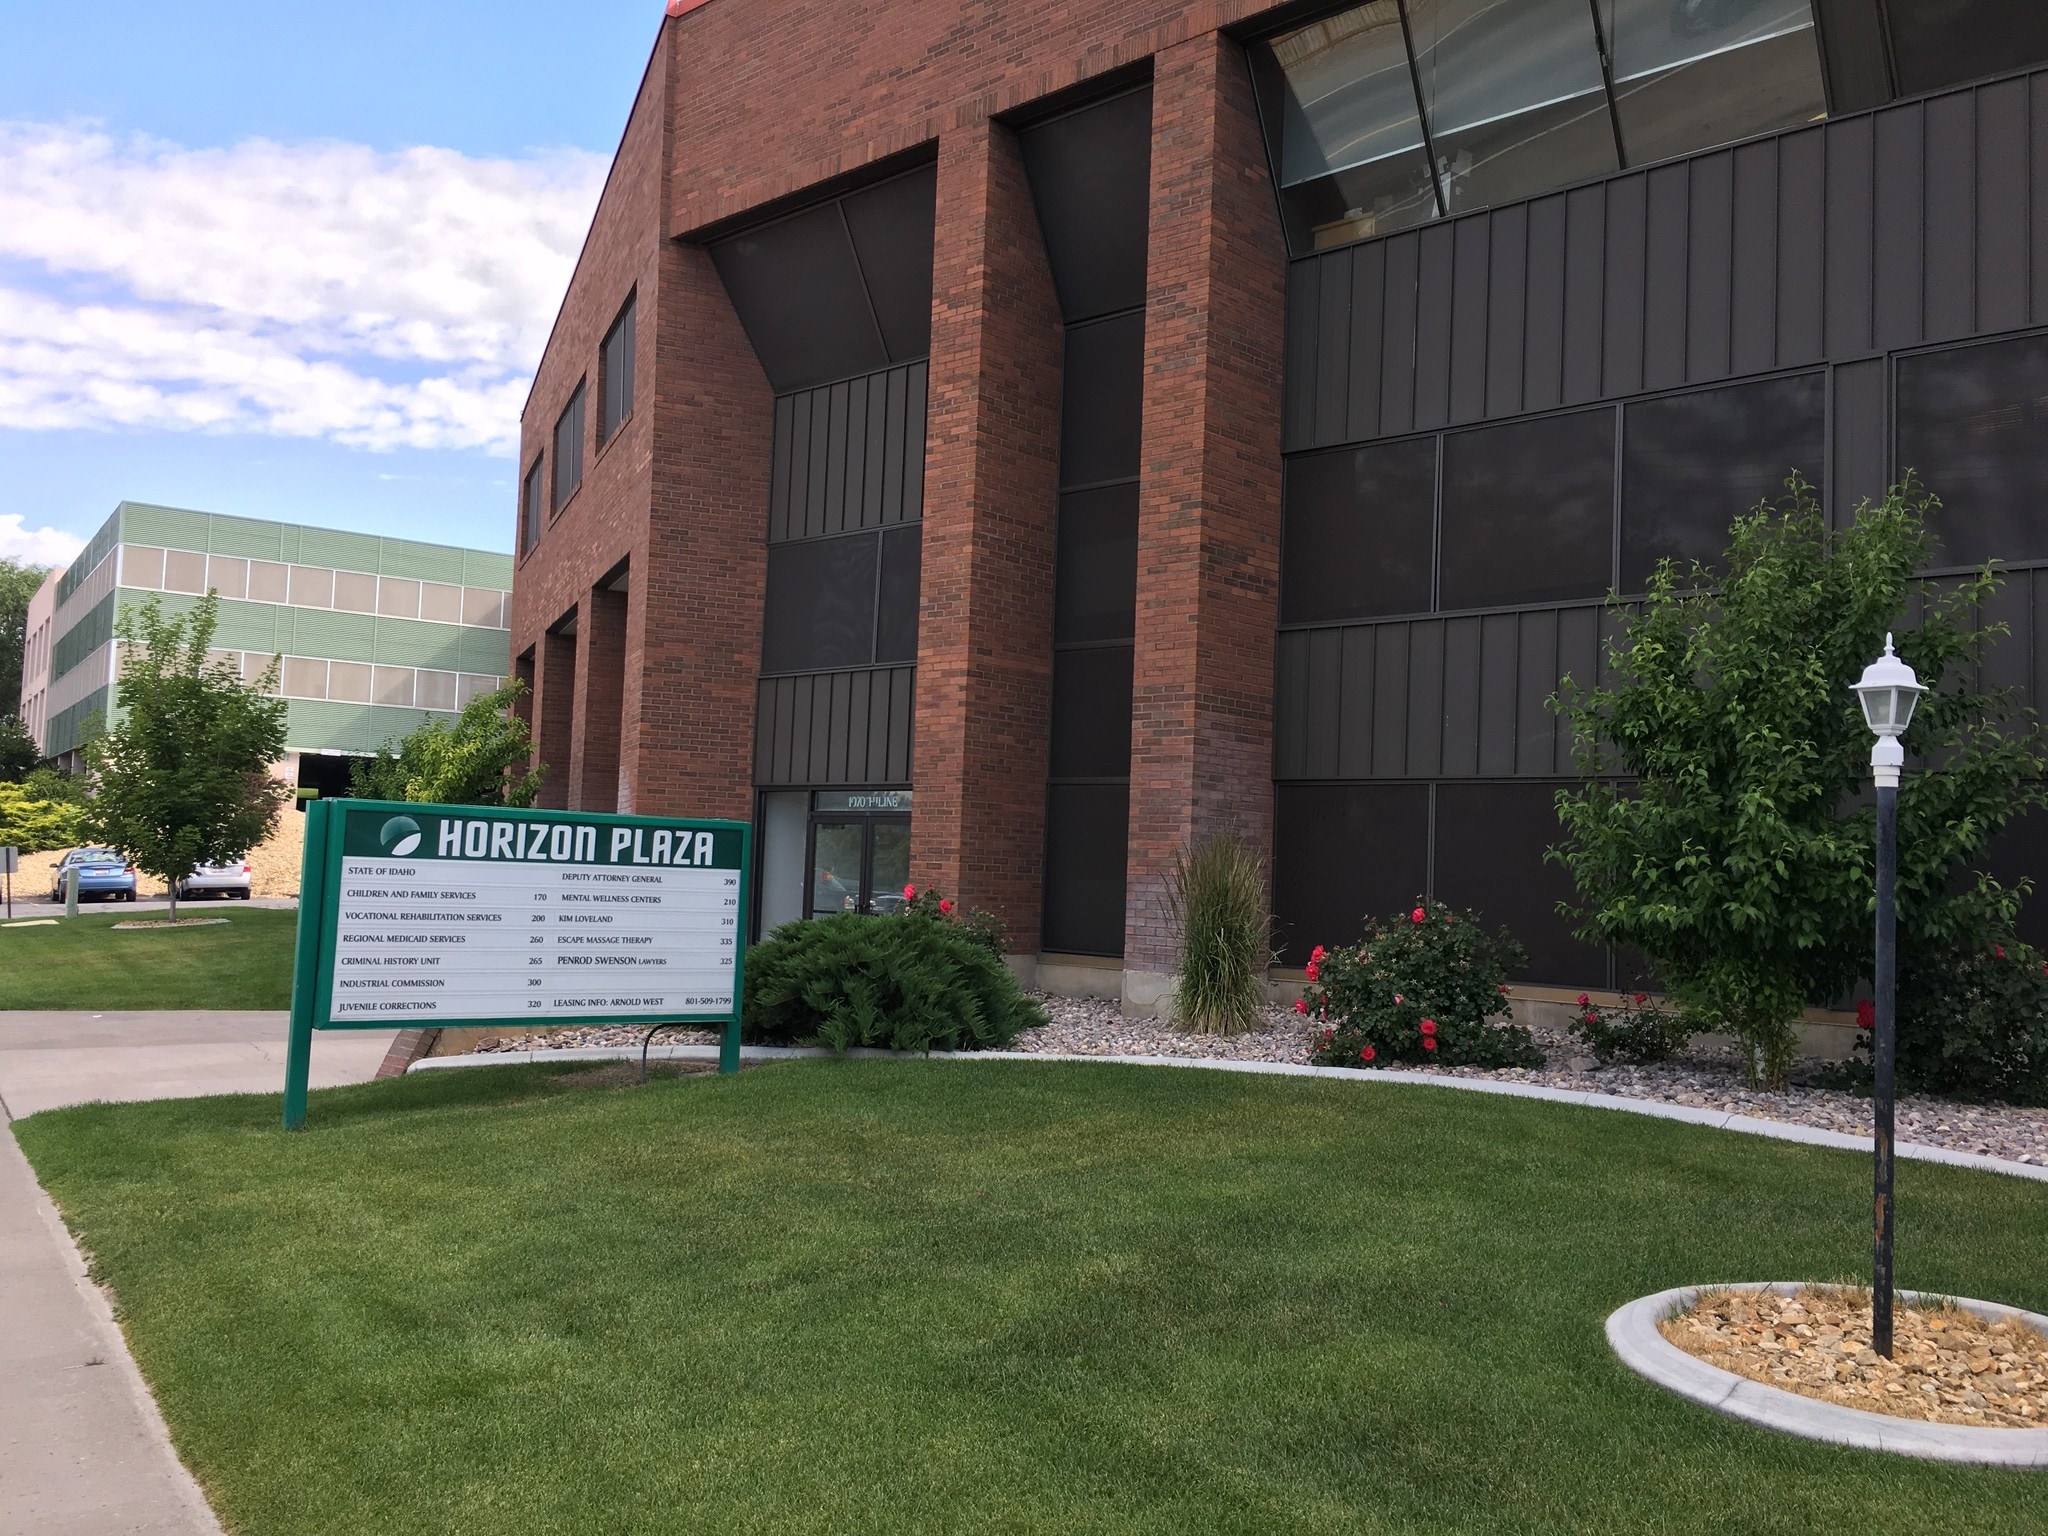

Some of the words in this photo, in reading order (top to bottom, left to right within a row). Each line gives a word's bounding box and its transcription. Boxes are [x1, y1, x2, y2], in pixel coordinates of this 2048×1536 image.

[438, 819, 597, 861] HORIZON
[610, 827, 714, 866] PLAZA
[348, 867, 373, 875] STATE
[389, 868, 415, 876] IDAHO
[562, 873, 591, 881] DEPUTY
[592, 874, 630, 882] ATTORNEY
[347, 890, 389, 898] CHILDREN
[391, 890, 409, 898] AND
[411, 891, 439, 899] FAMILY
[440, 892, 476, 900] SERVICES
[562, 894, 591, 902] MENTAL
[593, 895, 629, 903] WELLNESS
[630, 896, 661, 904] CENTERS
[345, 912, 398, 920] VOCATIONAL
[400, 913, 465, 921] REHABILITATION
[467, 914, 502, 922] SERVICES
[575, 915, 613, 923] LOVELAND
[387, 935, 427, 943] MEDICAID
[342, 957, 382, 965] CRIMINAL
[557, 957, 592, 965] PENROD
[594, 957, 637, 965] SWENSON
[610, 998, 642, 1006] ARNOLD
[685, 997, 732, 1005] 801-509-1799
[338, 1003, 378, 1012] JUVENILE
[379, 1002, 437, 1010] CORRECTIONS
